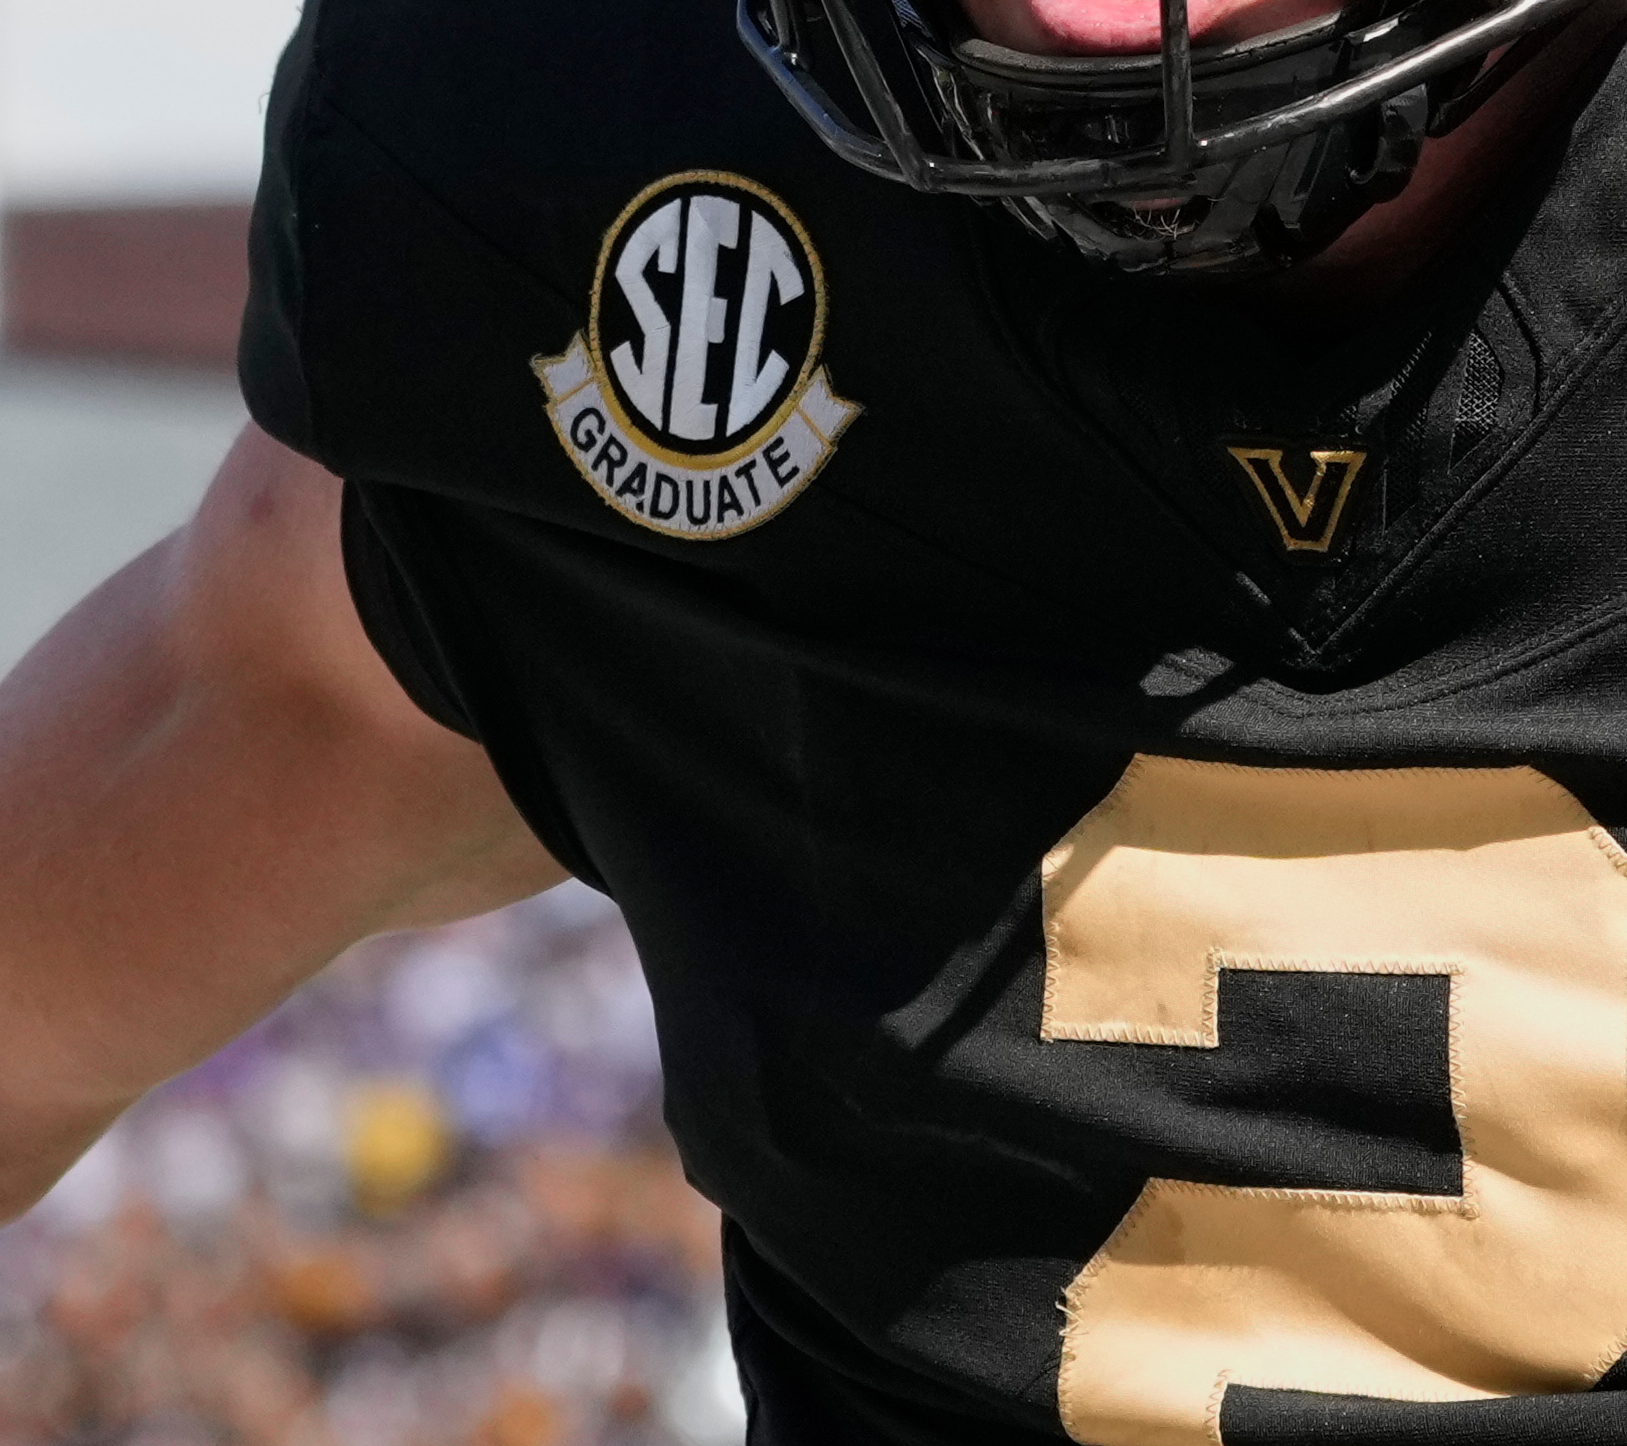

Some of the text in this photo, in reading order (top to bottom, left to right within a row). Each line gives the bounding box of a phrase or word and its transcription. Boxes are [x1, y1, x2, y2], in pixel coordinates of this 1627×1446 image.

[610, 194, 805, 441] SEC
[570, 406, 801, 527] GRADUATE
[1227, 446, 1368, 552] V
